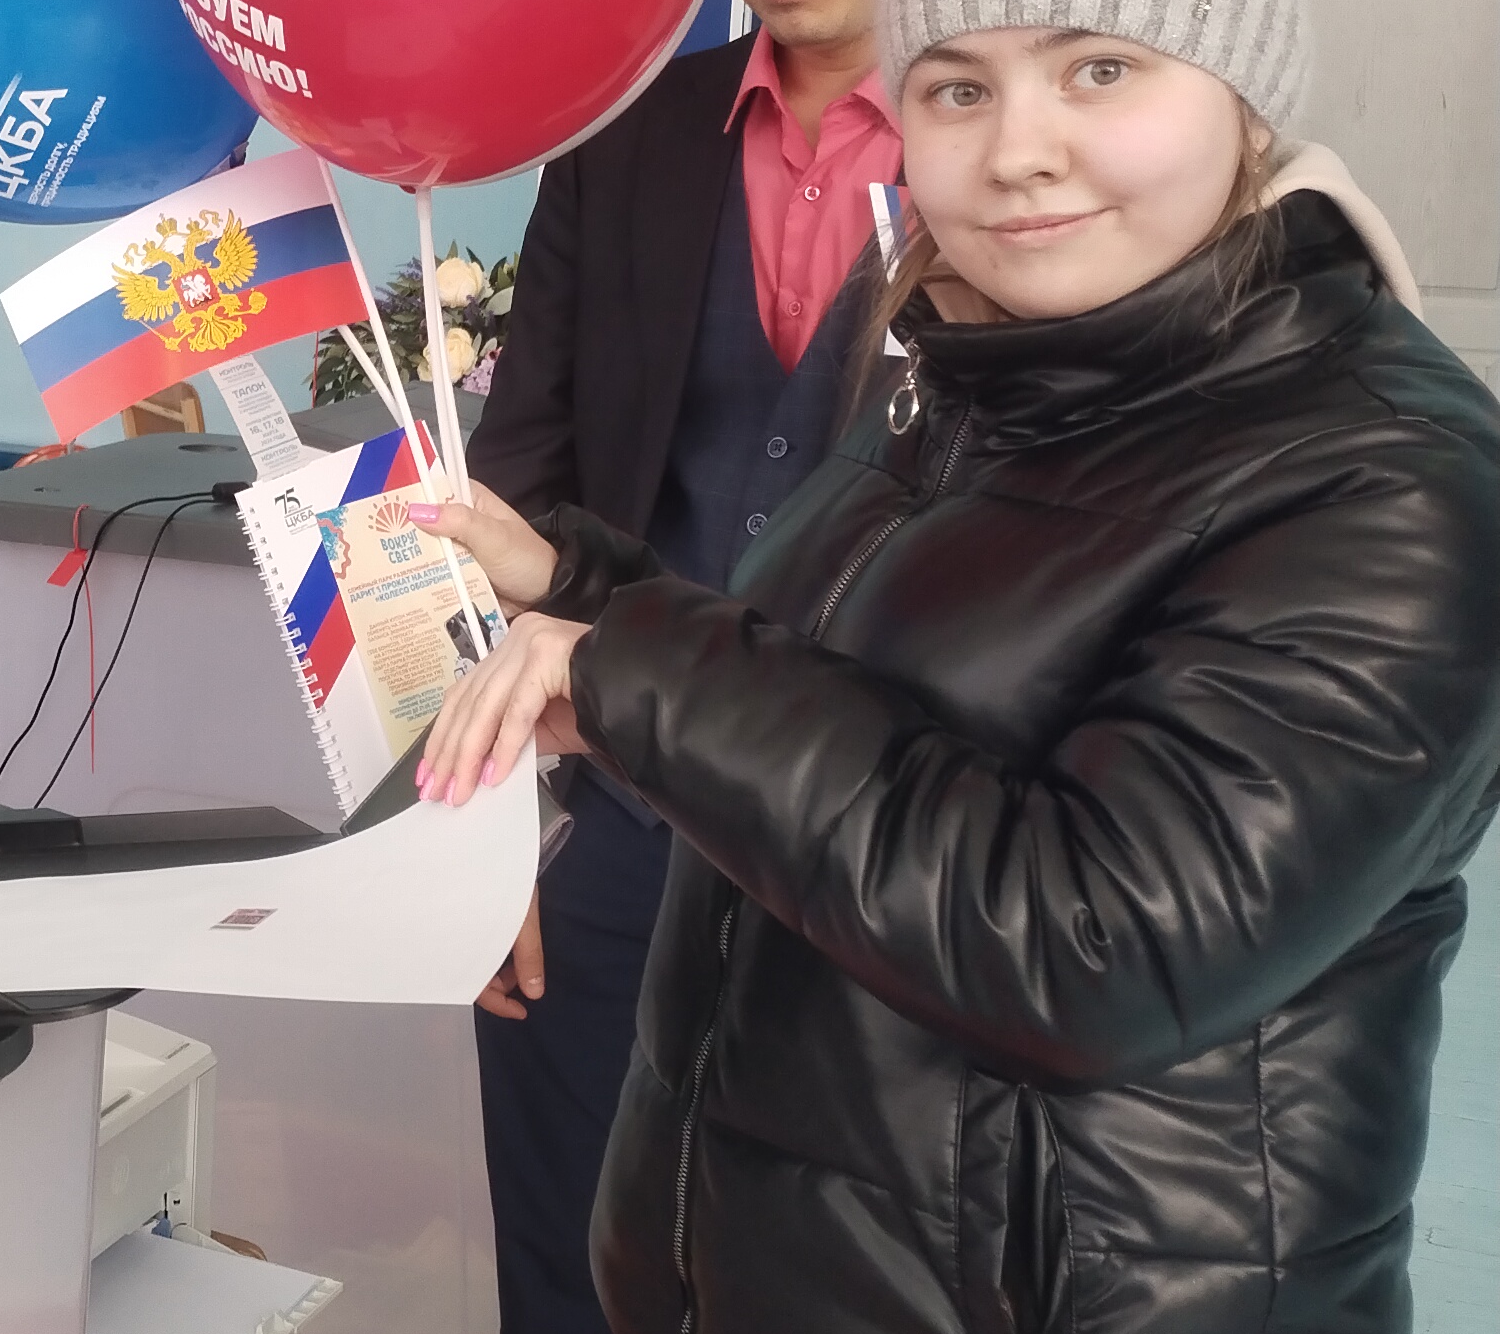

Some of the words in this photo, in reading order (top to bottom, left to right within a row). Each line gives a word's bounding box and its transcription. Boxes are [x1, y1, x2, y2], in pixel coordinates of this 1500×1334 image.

[232, 381, 266, 399] ТАЛОН
[274, 487, 301, 515] 75
[285, 509, 315, 528] ЦКБА
[380, 528, 418, 551] ВОКРУГ
[388, 544, 422, 564] СВЕТА
[350, 589, 376, 603] ДАРИТ
[381, 576, 411, 592] ПРОКАТ
[412, 573, 422, 582] НА
